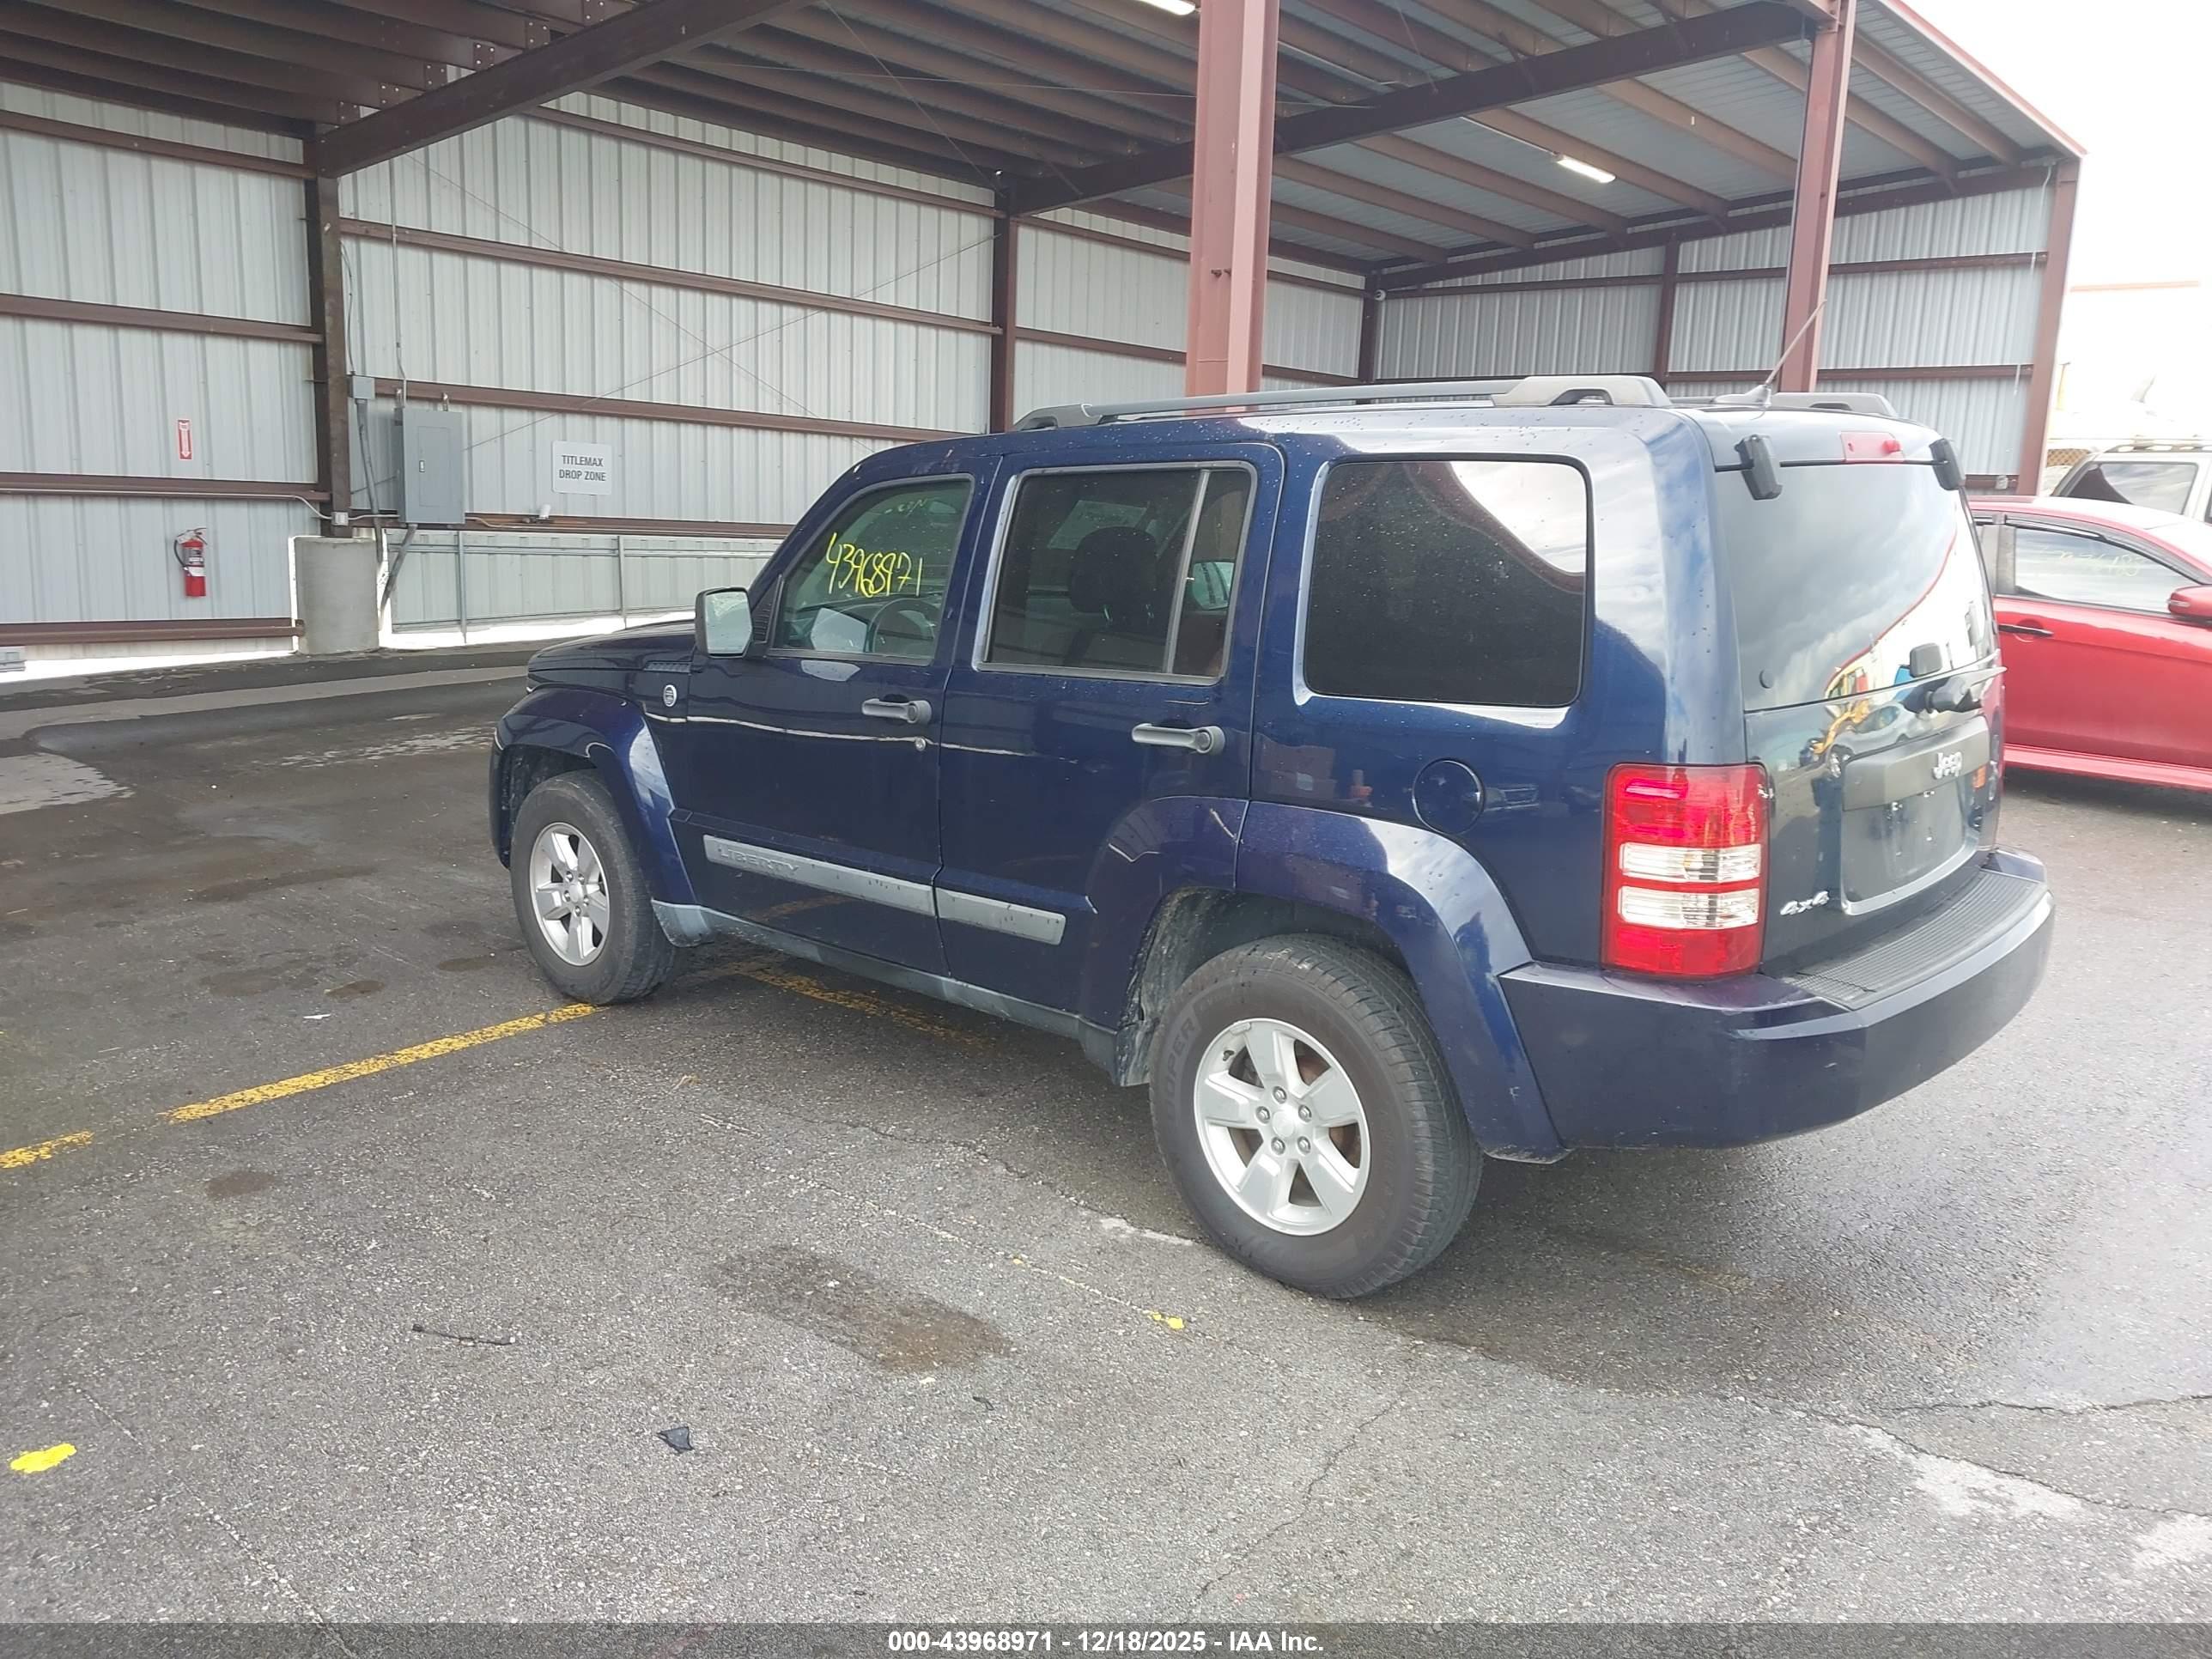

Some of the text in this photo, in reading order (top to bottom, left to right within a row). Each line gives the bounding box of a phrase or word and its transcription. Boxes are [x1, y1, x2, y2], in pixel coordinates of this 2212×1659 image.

[559, 469, 606, 481] DROP ZONE
[561, 454, 604, 467] TITLEMAX
[826, 532, 923, 598] 43968971
[1933, 751, 1962, 780] Jeep
[717, 846, 799, 875] LIBERTY
